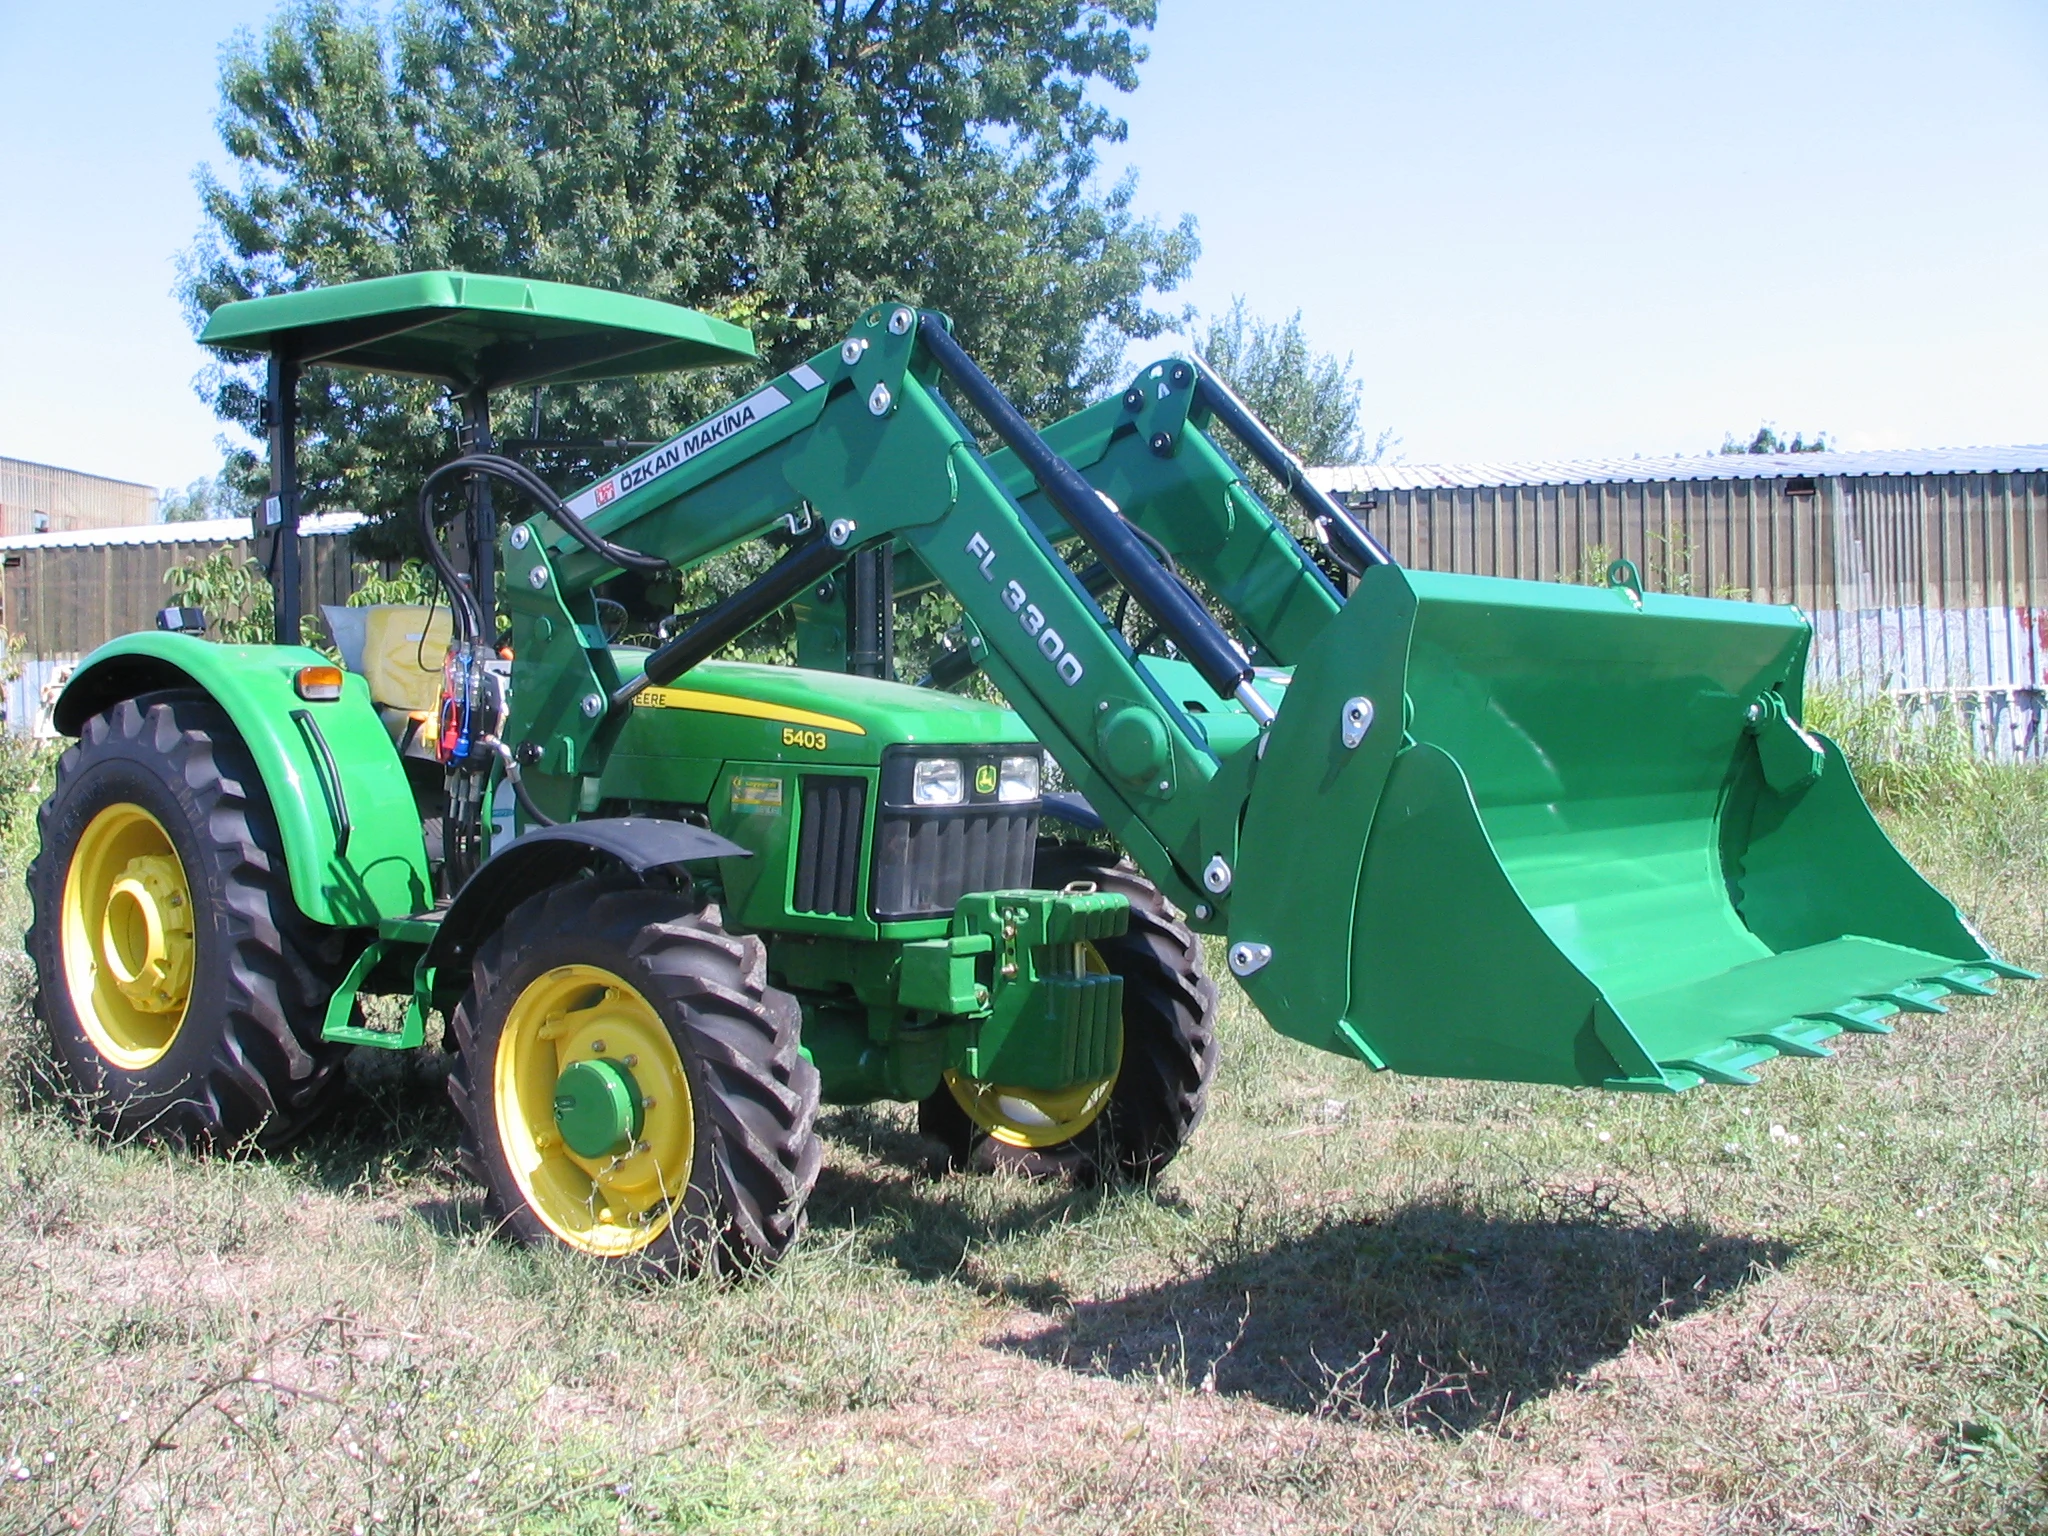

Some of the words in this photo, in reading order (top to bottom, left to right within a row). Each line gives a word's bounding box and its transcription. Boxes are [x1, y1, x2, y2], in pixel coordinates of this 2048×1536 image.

[620, 447, 680, 492] ÖZKAN
[683, 406, 756, 458] MAKİNA
[965, 532, 996, 583] FL
[1001, 579, 1083, 687] 3300
[633, 692, 667, 706] EERE
[782, 727, 827, 750] 5403
